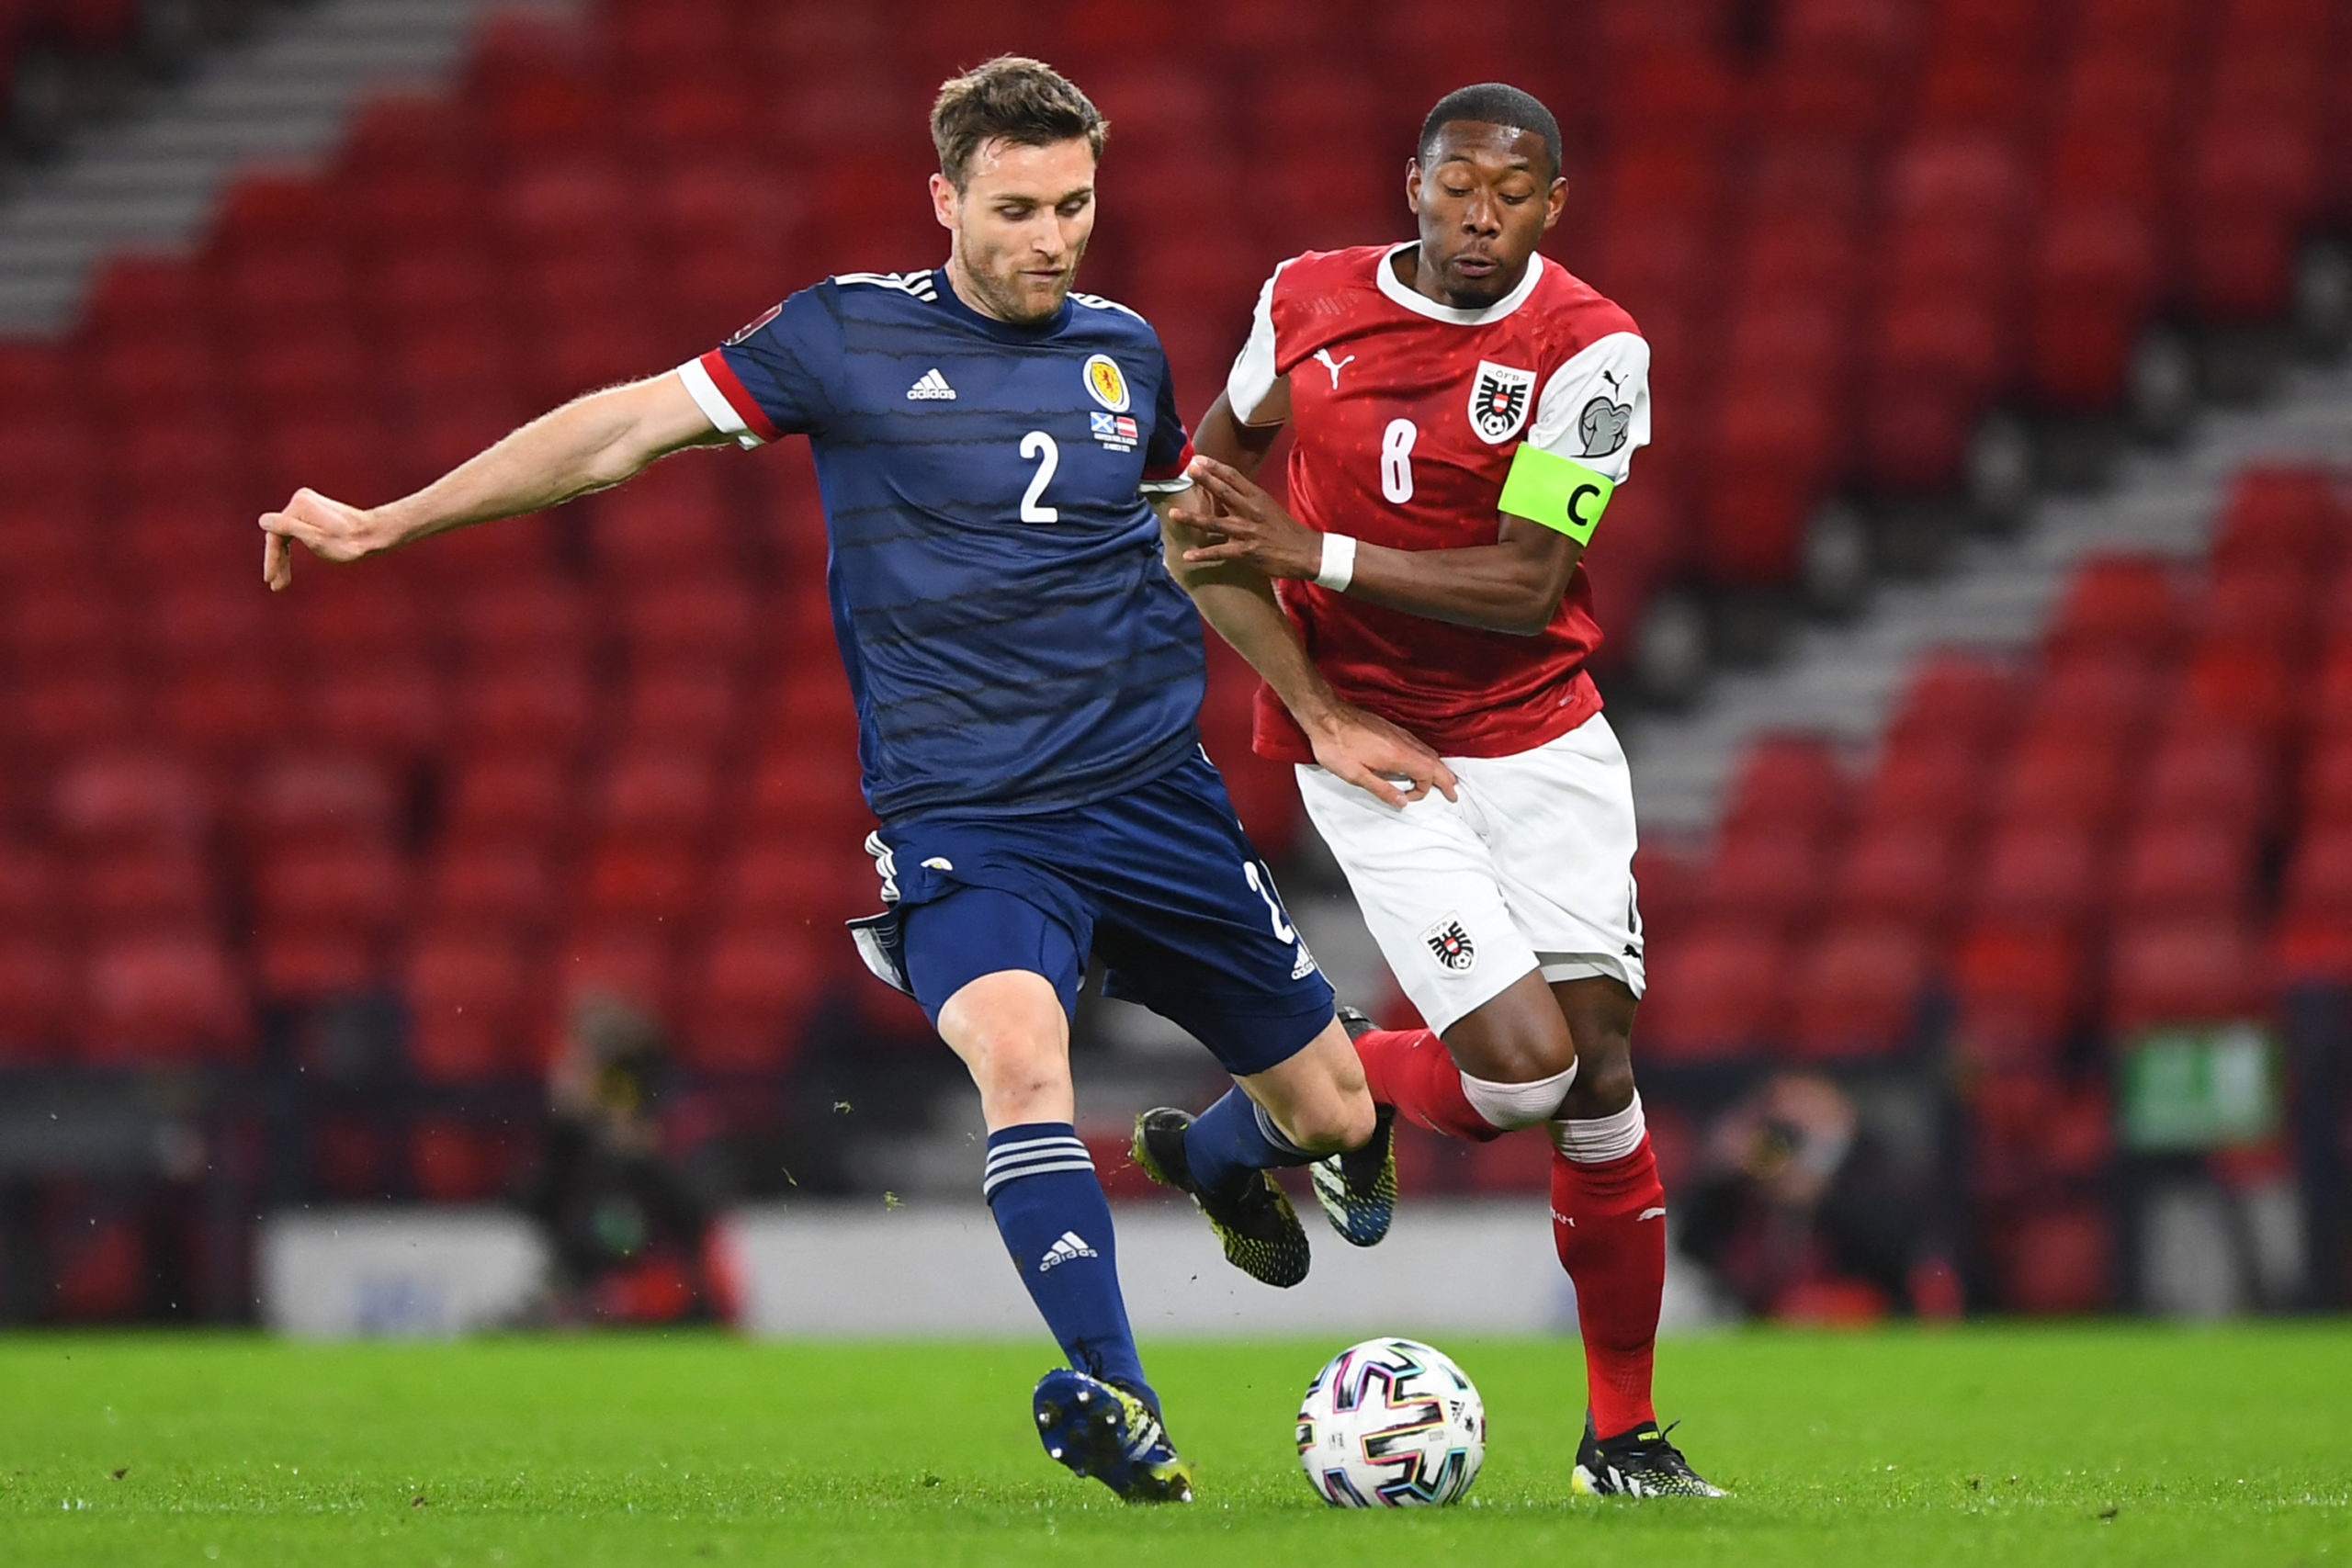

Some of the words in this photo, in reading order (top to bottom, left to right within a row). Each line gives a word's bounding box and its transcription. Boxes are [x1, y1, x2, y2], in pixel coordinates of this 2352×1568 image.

[907, 388, 956, 400] adidas
[1020, 431, 1058, 523] 2
[1381, 419, 1417, 503] 8
[1567, 484, 1600, 525] C
[1244, 862, 1295, 944] 2
[1039, 1248, 1097, 1271] adidas
